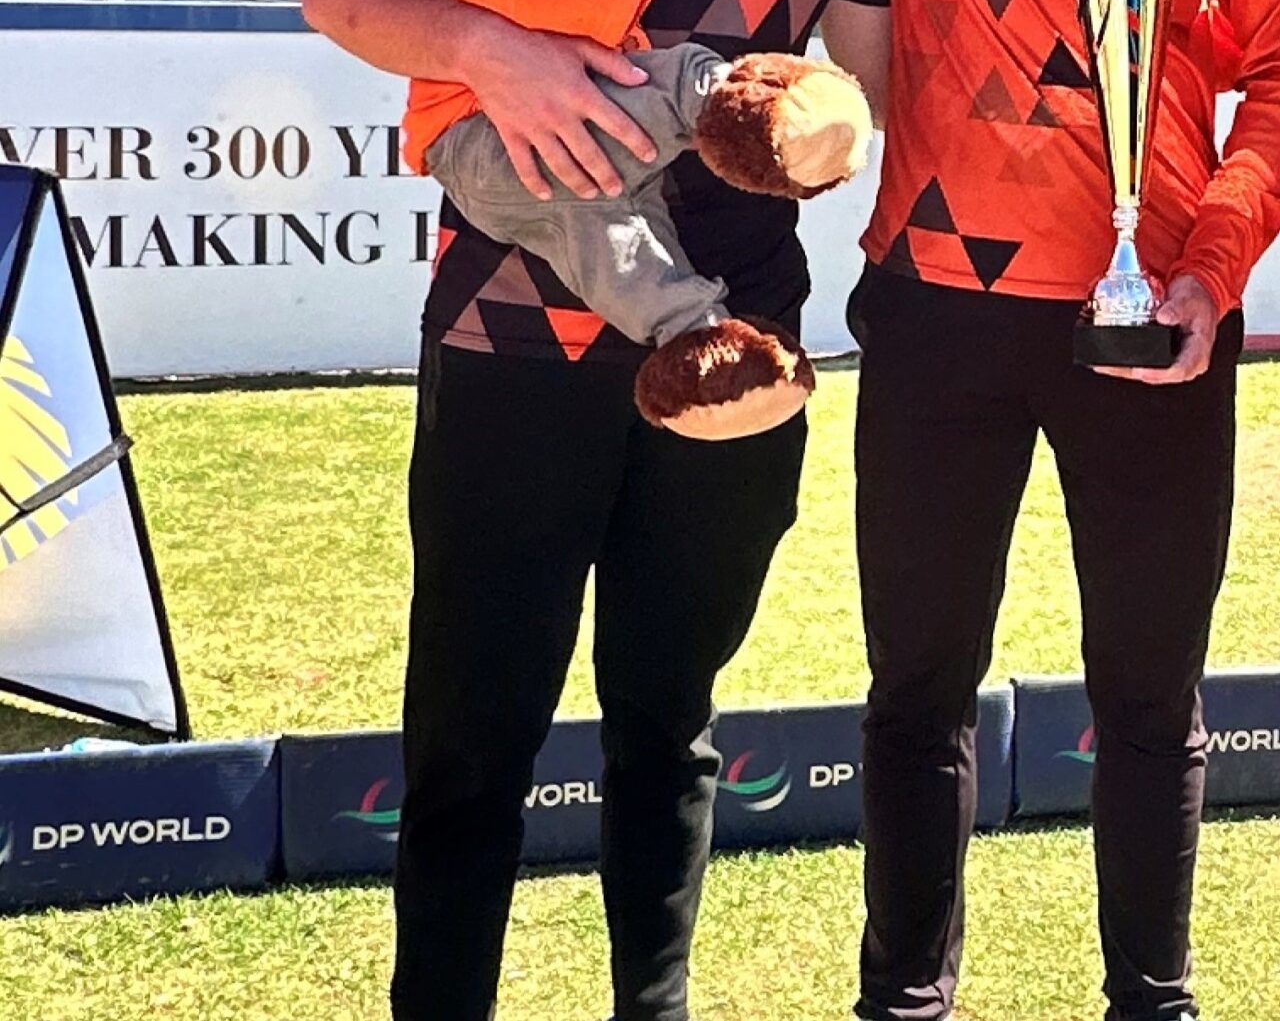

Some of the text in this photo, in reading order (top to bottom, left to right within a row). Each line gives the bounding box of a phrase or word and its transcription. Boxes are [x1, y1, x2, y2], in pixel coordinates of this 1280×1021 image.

[184, 125, 310, 179] 300
[70, 211, 386, 268] MAKING
[810, 763, 854, 788] DP
[33, 816, 231, 850] DP WORLD
